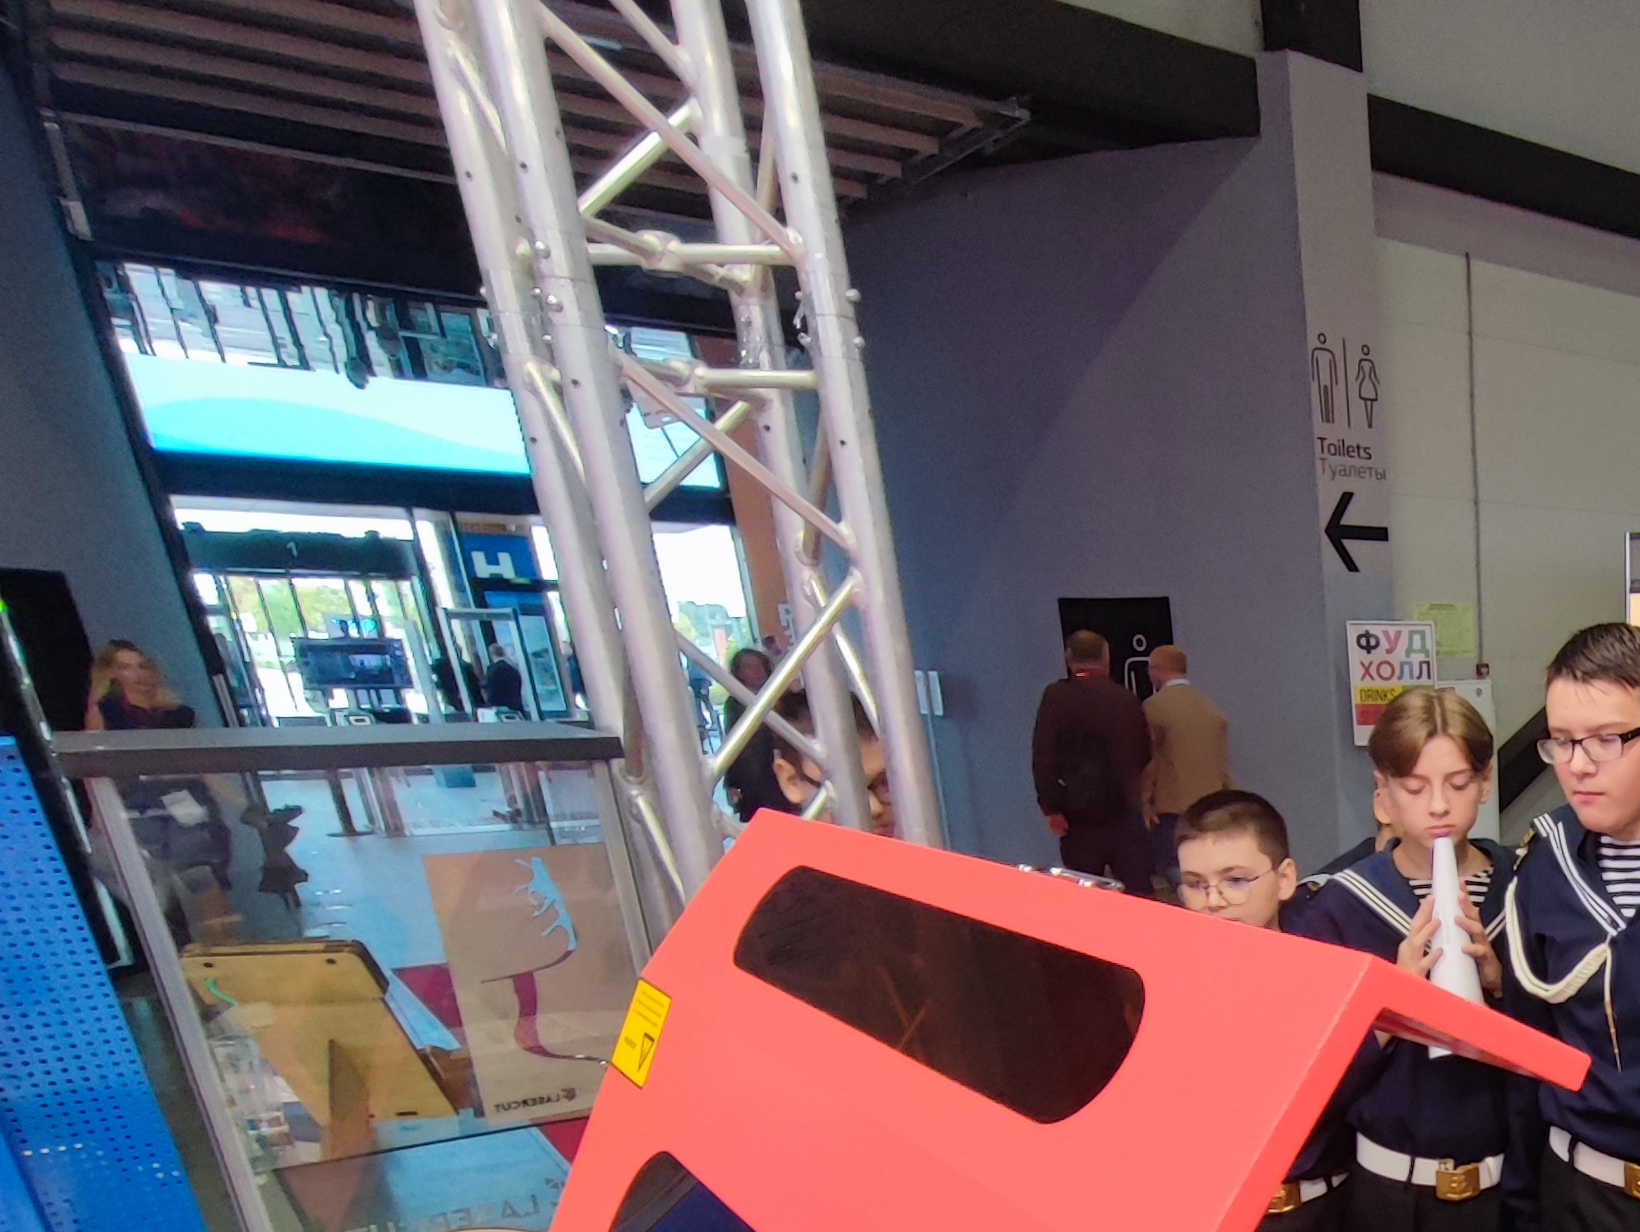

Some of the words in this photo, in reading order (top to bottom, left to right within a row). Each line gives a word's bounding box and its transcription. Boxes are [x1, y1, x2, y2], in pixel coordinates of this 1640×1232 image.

[1316, 436, 1372, 460] Toilets
[1319, 457, 1386, 481] Туалеты
[1356, 630, 1430, 658] ФУД
[1360, 660, 1431, 681] ХОЛЛ
[1359, 688, 1396, 703] DRINKS
